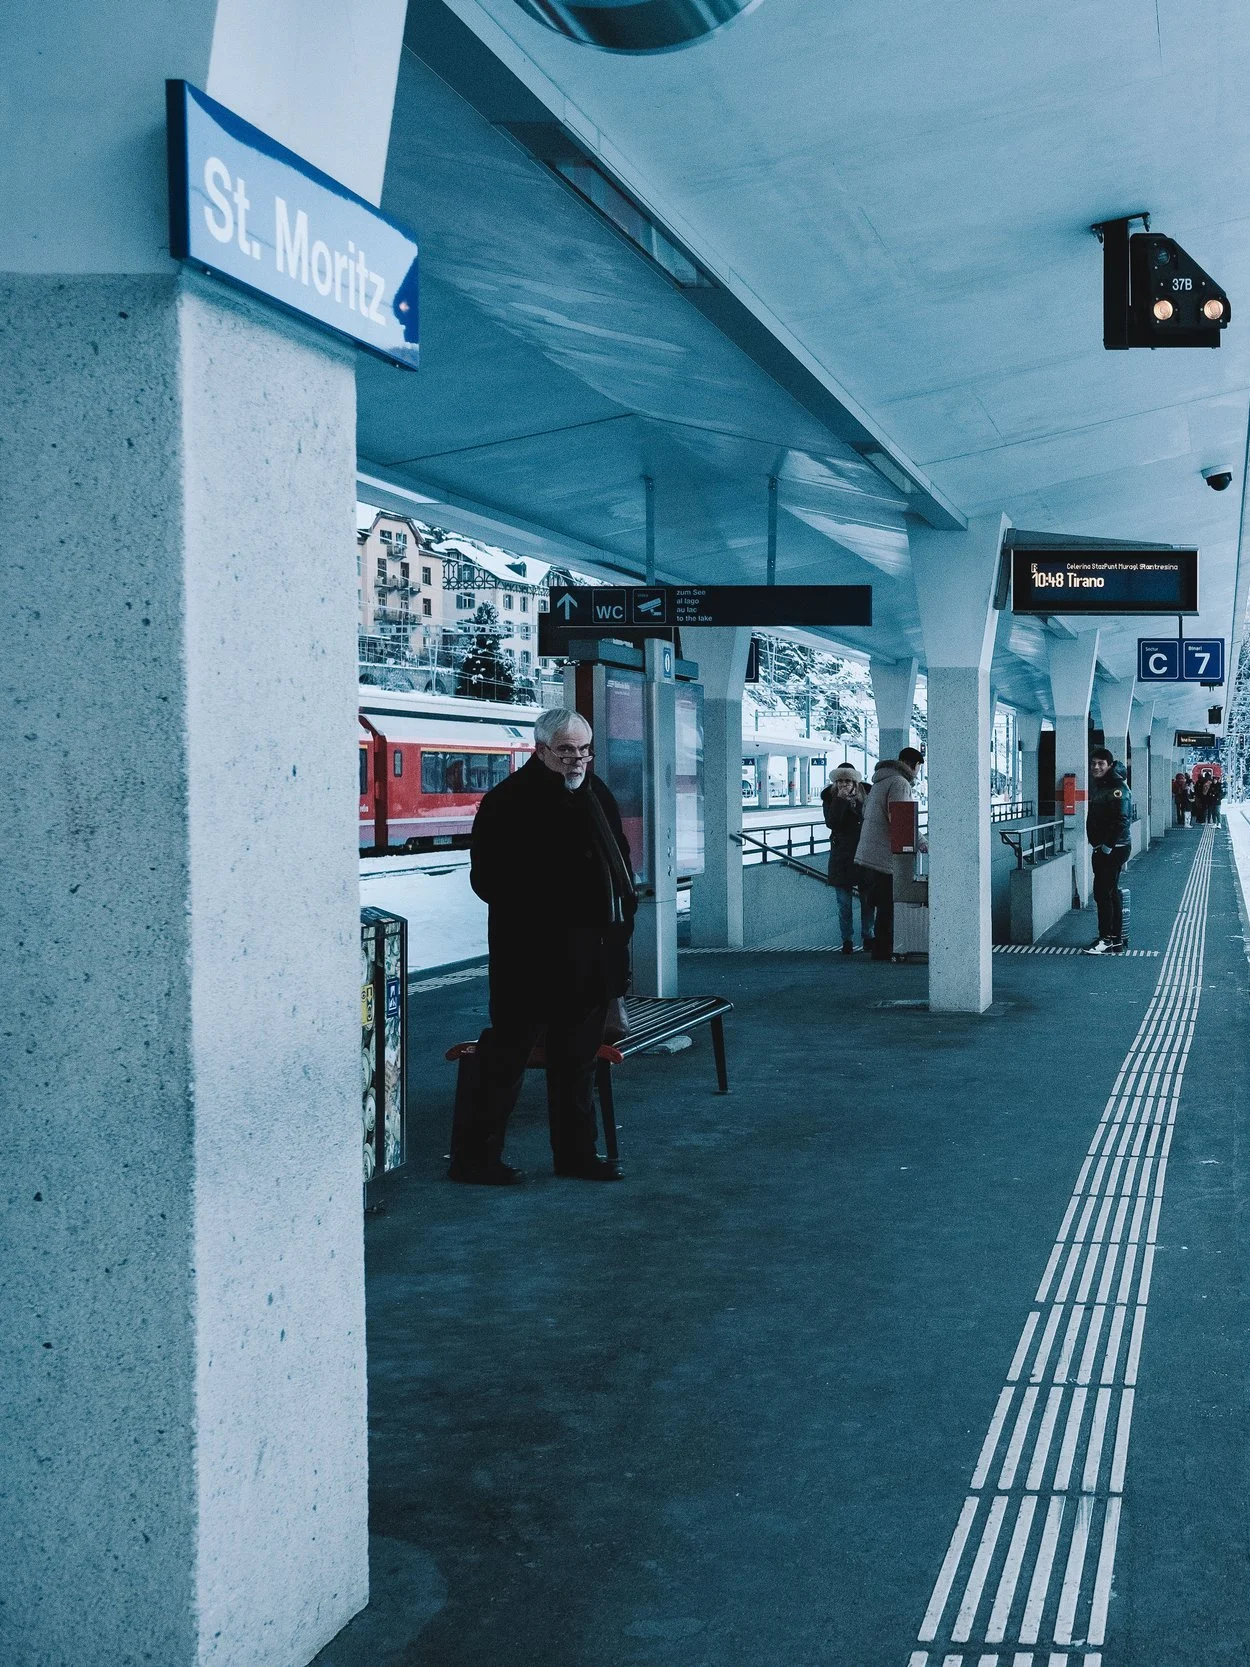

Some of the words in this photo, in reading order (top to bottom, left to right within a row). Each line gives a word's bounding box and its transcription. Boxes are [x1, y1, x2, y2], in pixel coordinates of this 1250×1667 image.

[203, 155, 261, 260] St.
[274, 195, 387, 326] Moritz
[1172, 278, 1192, 290] 37B
[1031, 572, 1064, 588] 10:48
[1066, 572, 1105, 588] Tirano
[693, 588, 706, 596] See
[684, 598, 700, 606] lago
[596, 606, 623, 619] WC
[1149, 653, 1167, 674] C
[1195, 653, 1210, 674] 7
